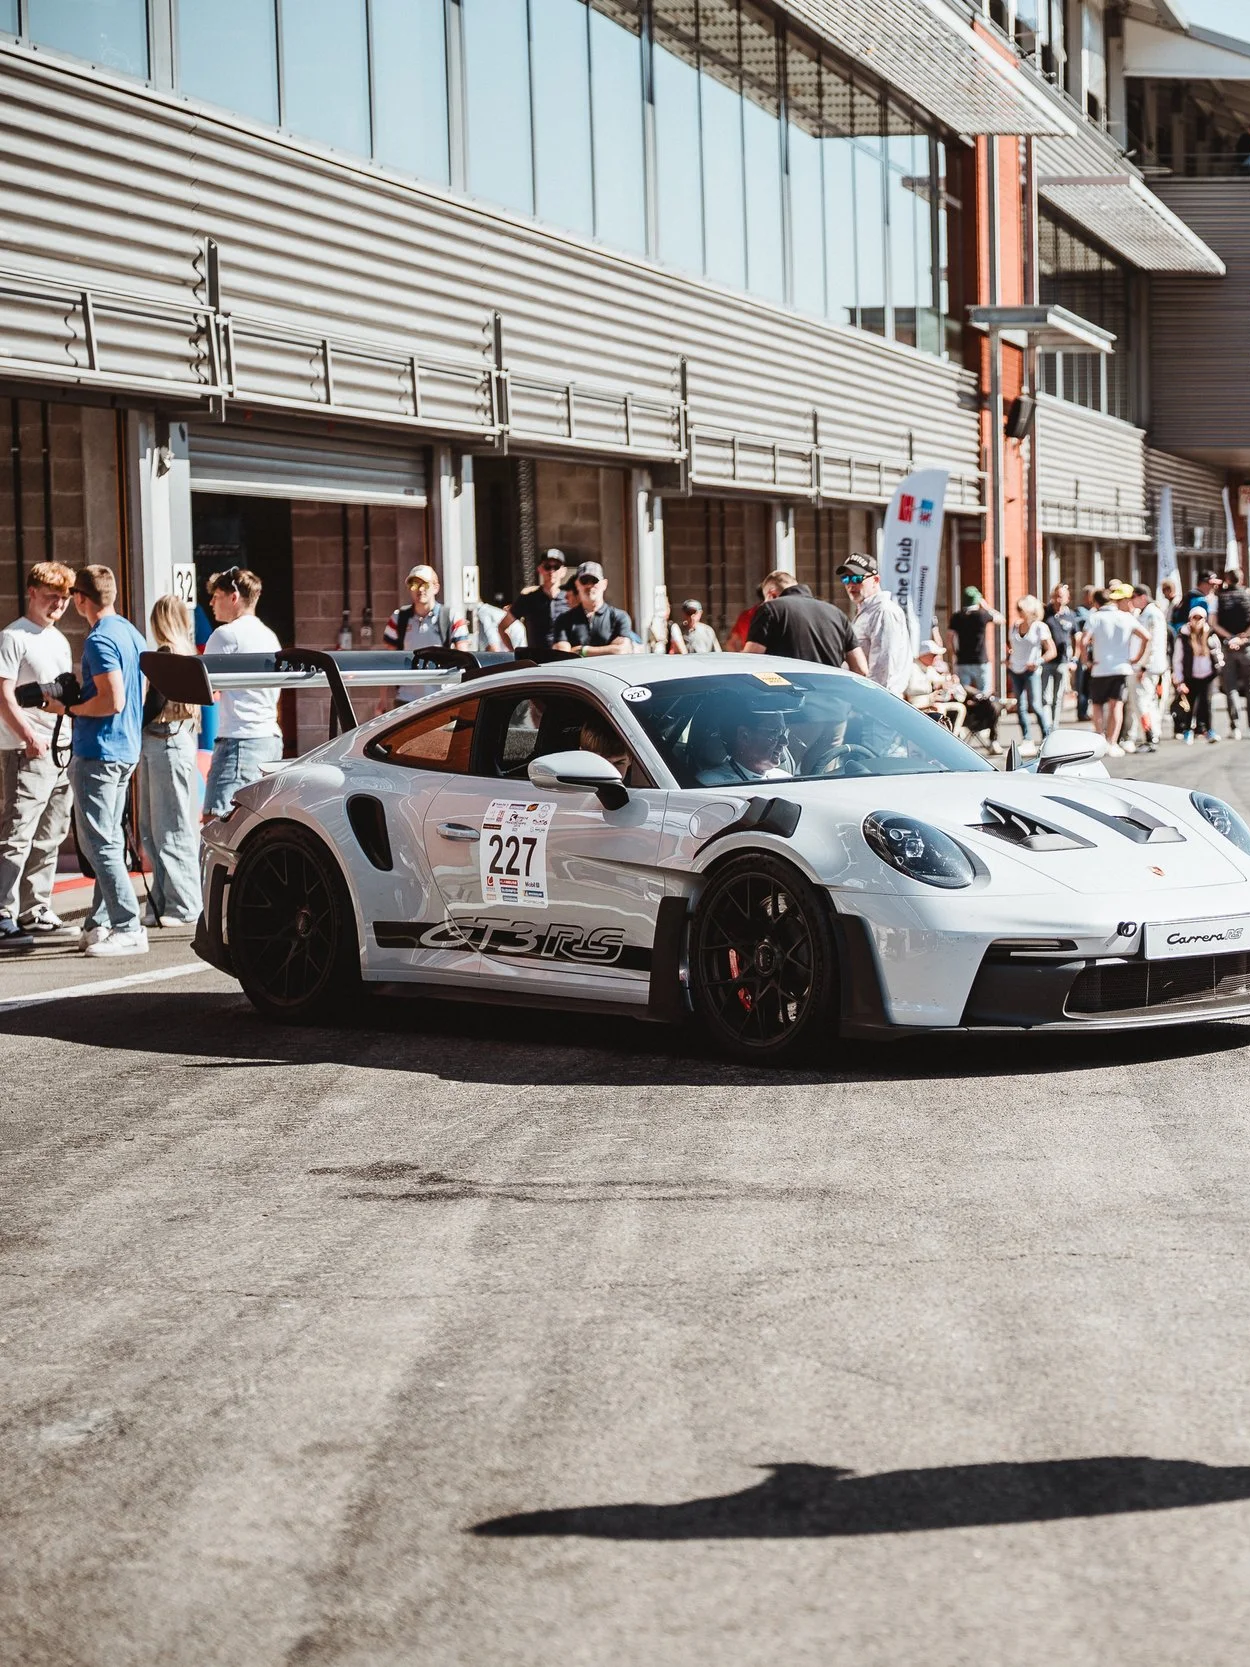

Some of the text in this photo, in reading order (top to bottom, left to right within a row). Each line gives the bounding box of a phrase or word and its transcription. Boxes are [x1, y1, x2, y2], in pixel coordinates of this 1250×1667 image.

[895, 537, 913, 574] Club
[627, 690, 646, 700] 227
[489, 834, 537, 877] 227
[1166, 932, 1225, 946] Carrera
